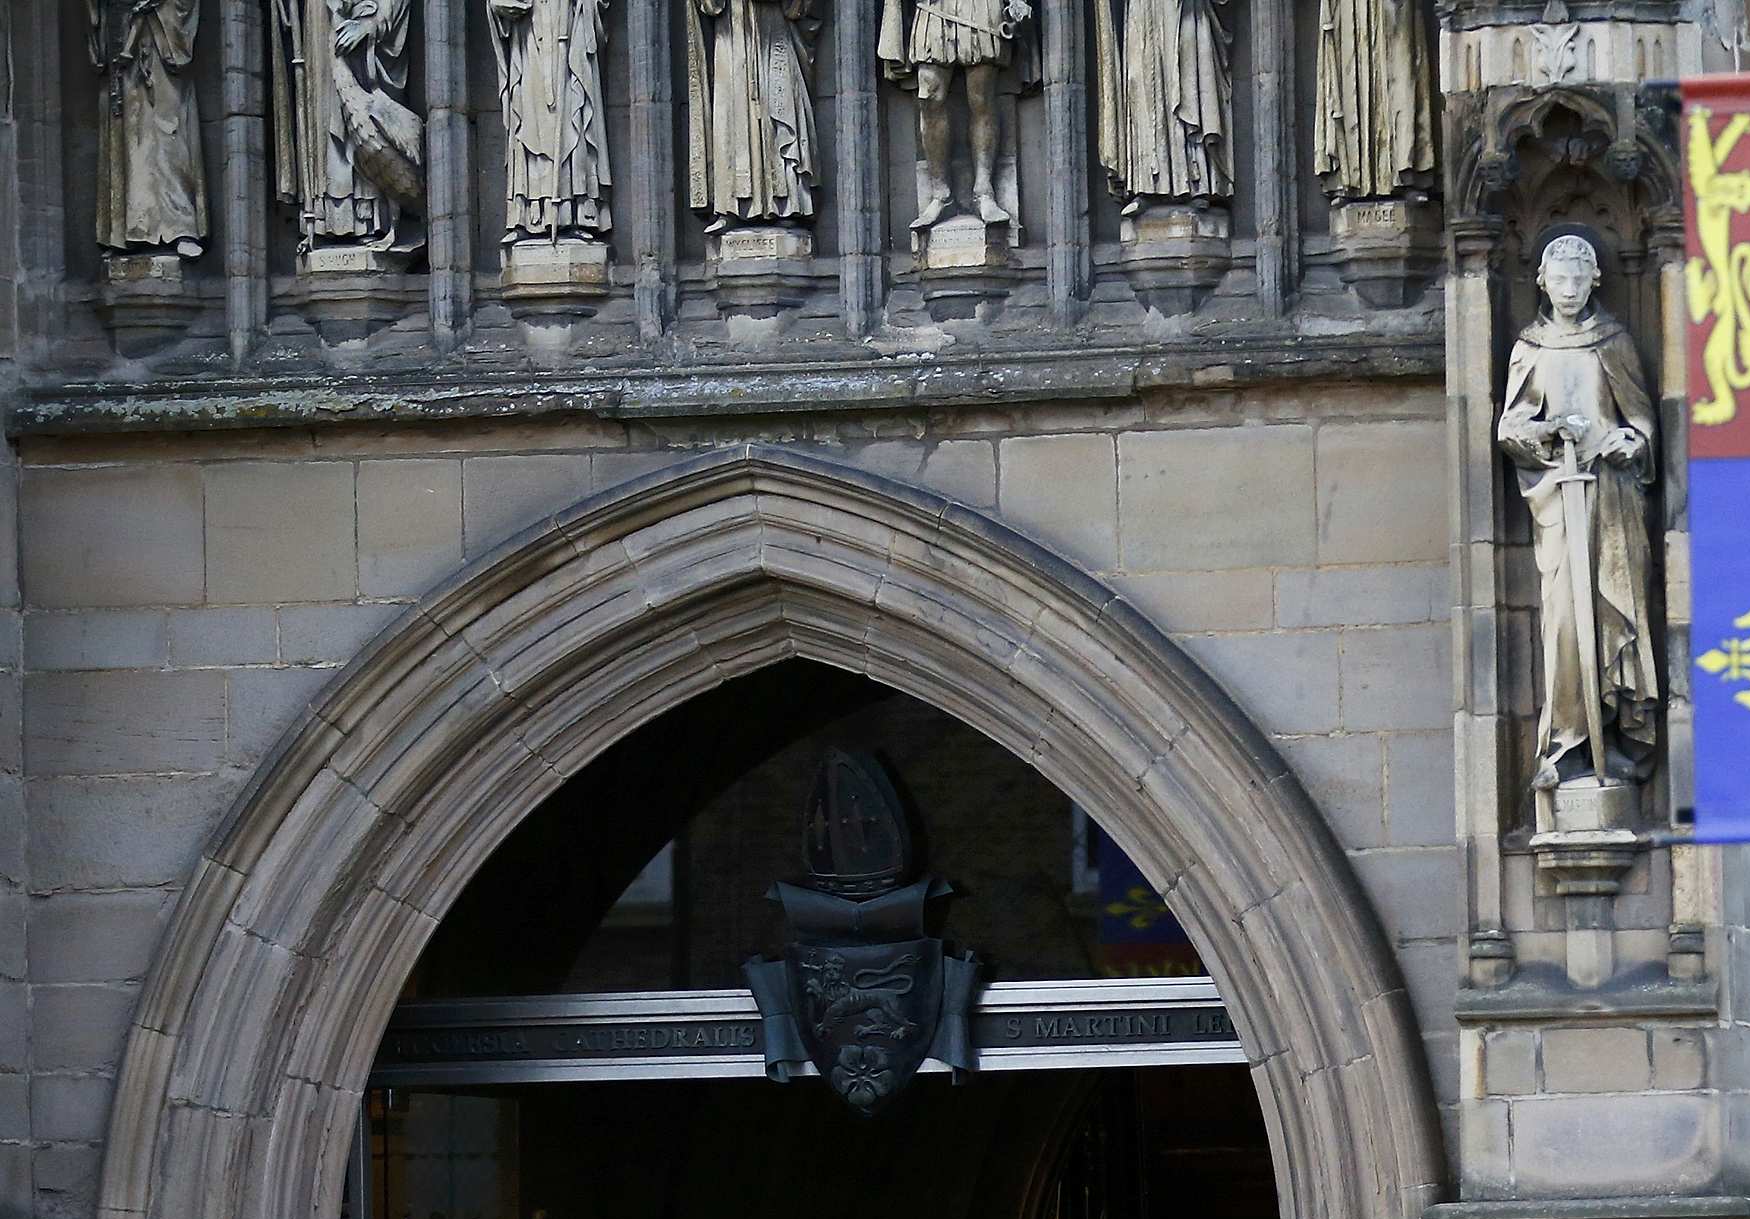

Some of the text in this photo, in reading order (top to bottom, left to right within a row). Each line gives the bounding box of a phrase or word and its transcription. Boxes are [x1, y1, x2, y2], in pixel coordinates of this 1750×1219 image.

[553, 1024, 756, 1052] CATHEDRALIS
[1006, 1017, 1022, 1039] S
[1034, 1014, 1172, 1039] MARTINI
